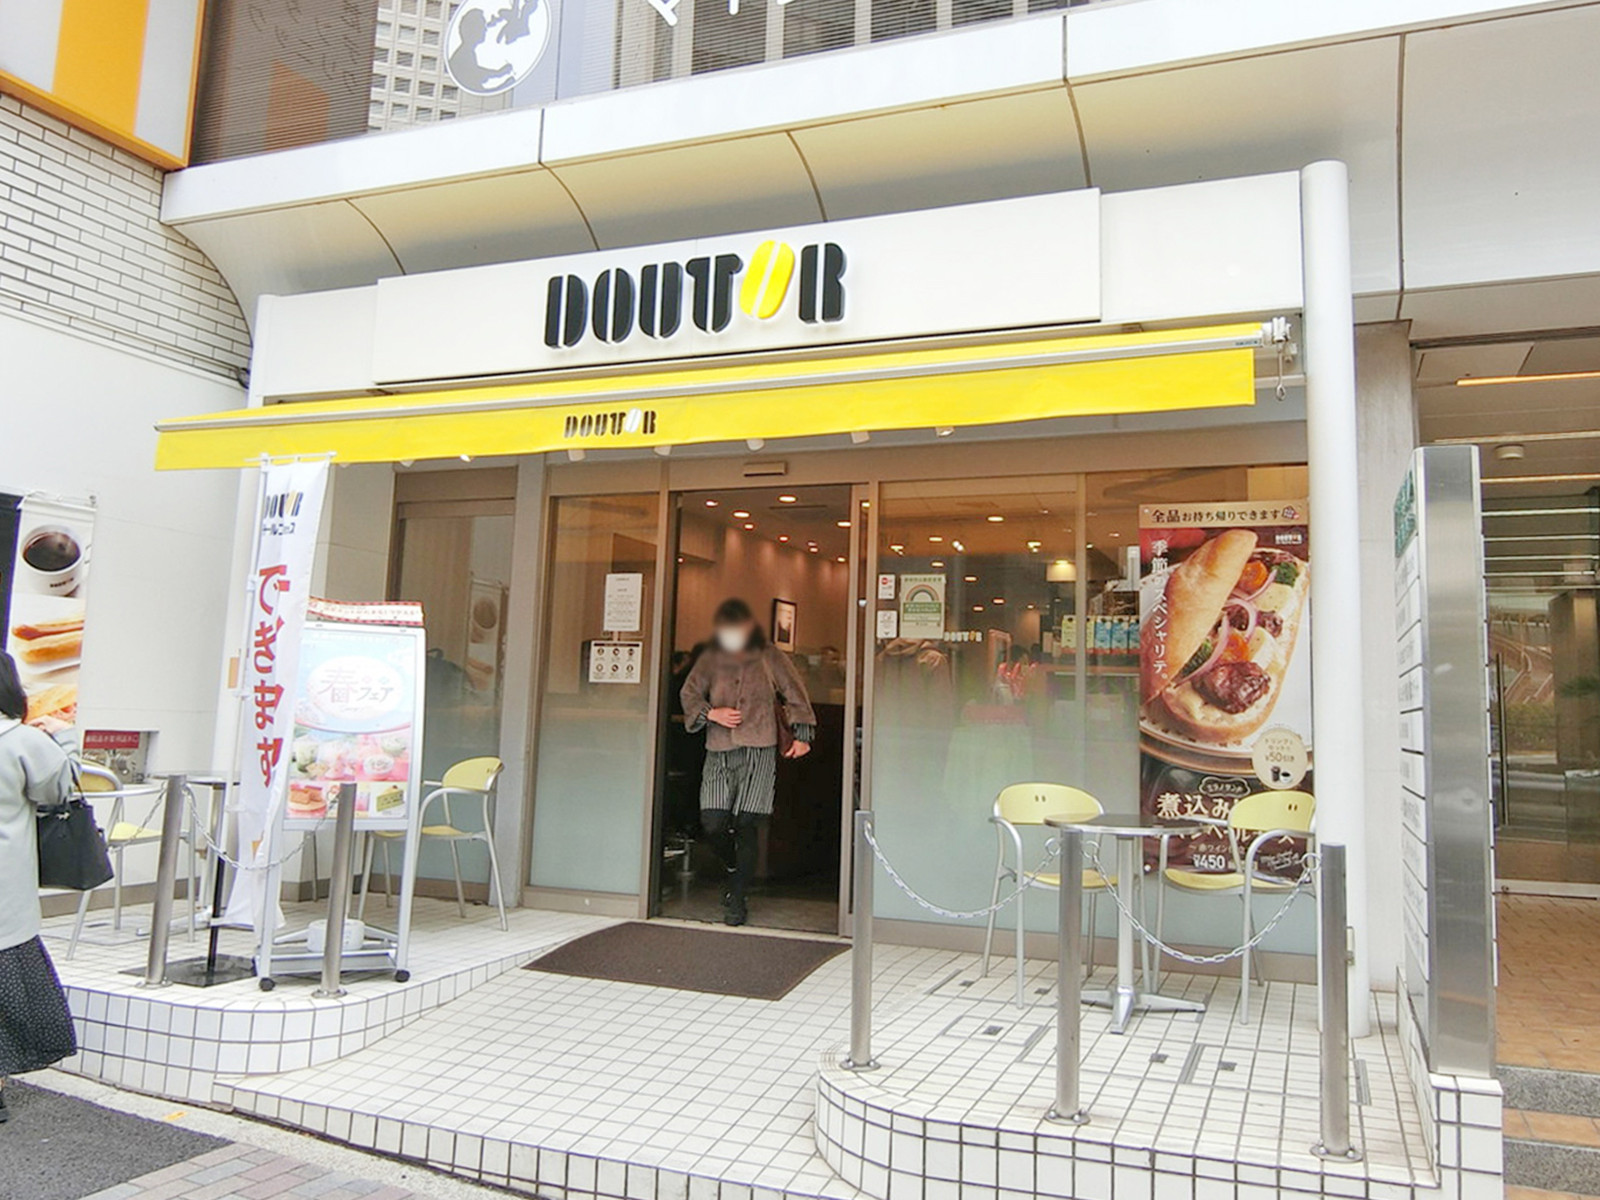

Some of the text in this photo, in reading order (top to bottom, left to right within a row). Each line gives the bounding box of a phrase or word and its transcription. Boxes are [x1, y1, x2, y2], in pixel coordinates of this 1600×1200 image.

[544, 239, 847, 348] DOUTOR
[564, 408, 657, 438] DOUTOR
[1151, 508, 1281, 524] 全品お持ち帰りできます
[254, 564, 291, 788] できます
[317, 666, 394, 703] 春フェア
[1193, 853, 1226, 870] ¥450
